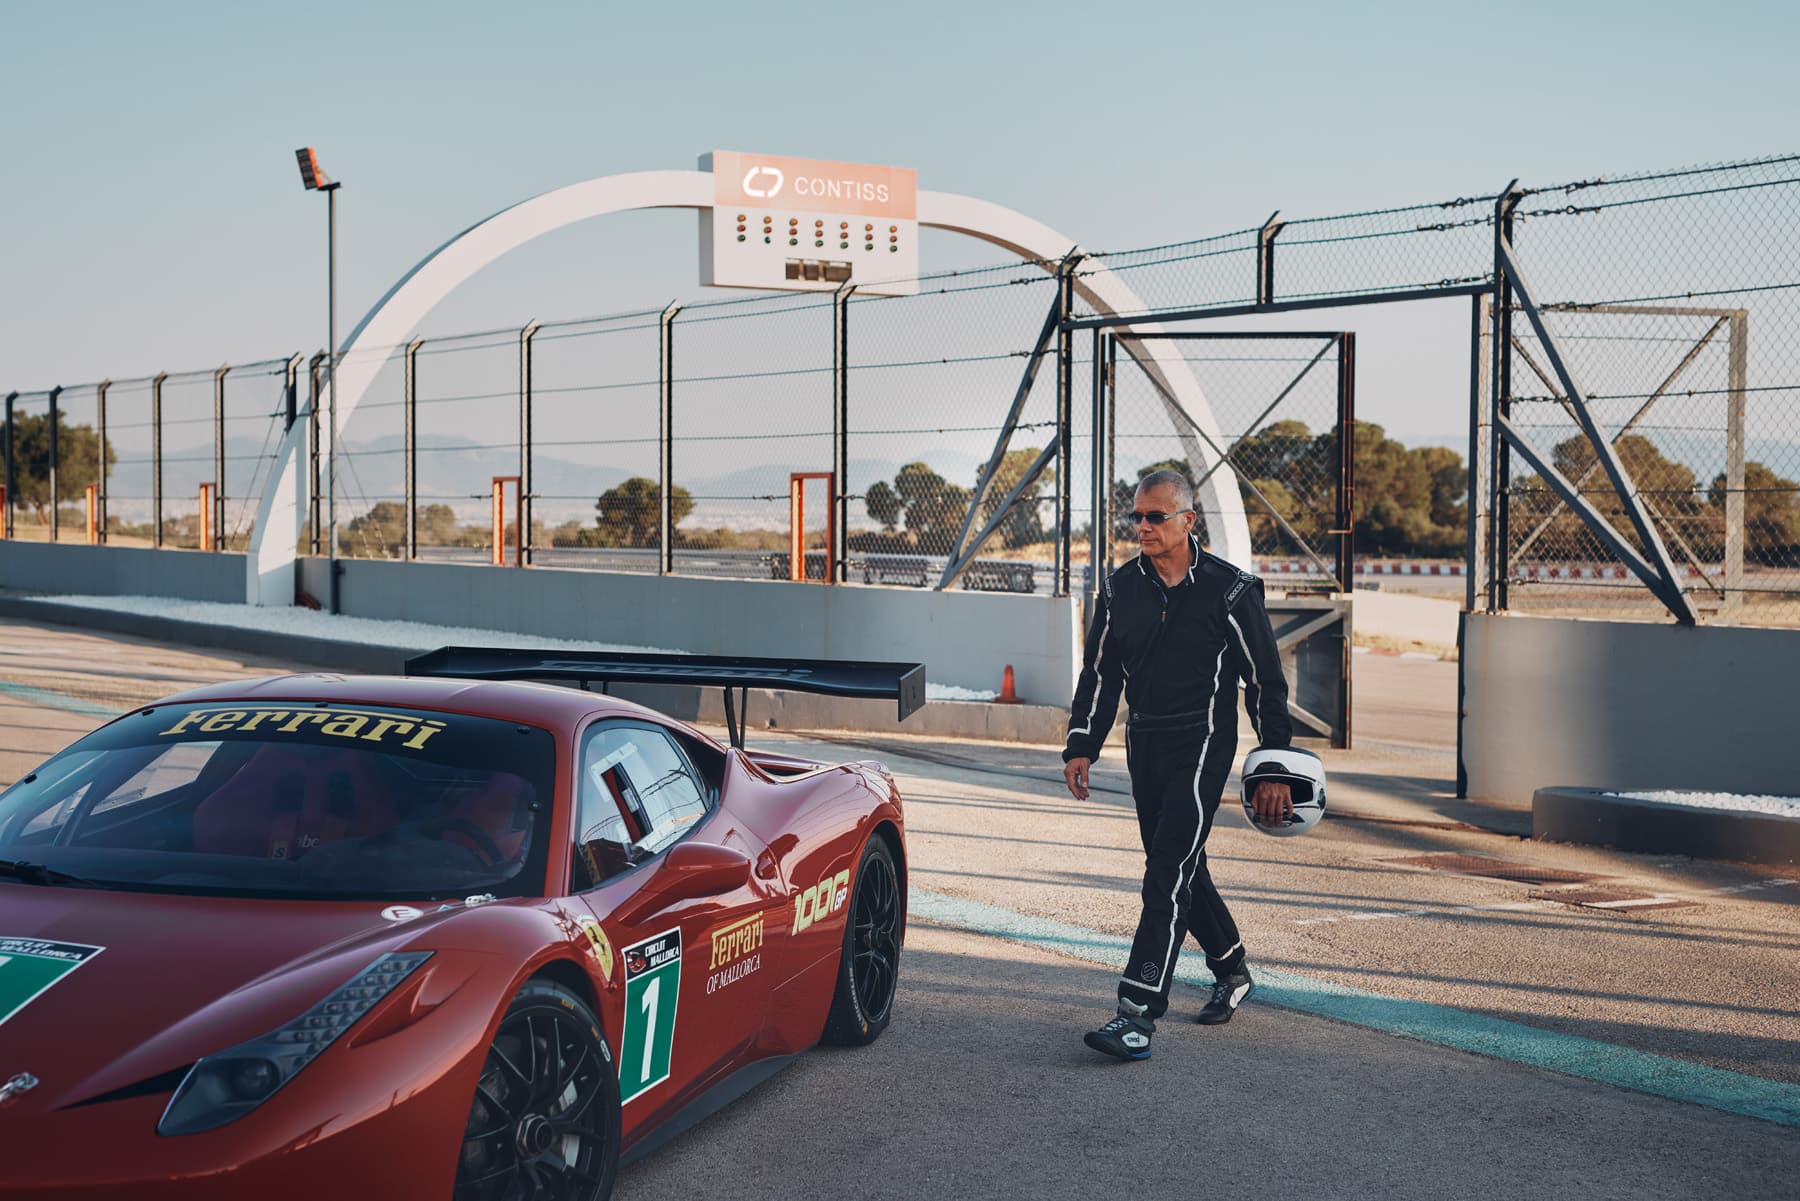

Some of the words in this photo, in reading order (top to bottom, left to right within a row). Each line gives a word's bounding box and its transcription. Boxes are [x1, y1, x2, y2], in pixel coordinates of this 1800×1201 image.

[794, 176, 889, 202] CONTISS
[159, 706, 447, 750] Ferrari
[644, 939, 666, 957] CIRCUIT
[650, 946, 680, 967] MALLORCA
[709, 910, 764, 971] Ferrari
[706, 972, 720, 995] OF
[718, 953, 761, 989] MALLORCA
[640, 976, 660, 1083] 1
